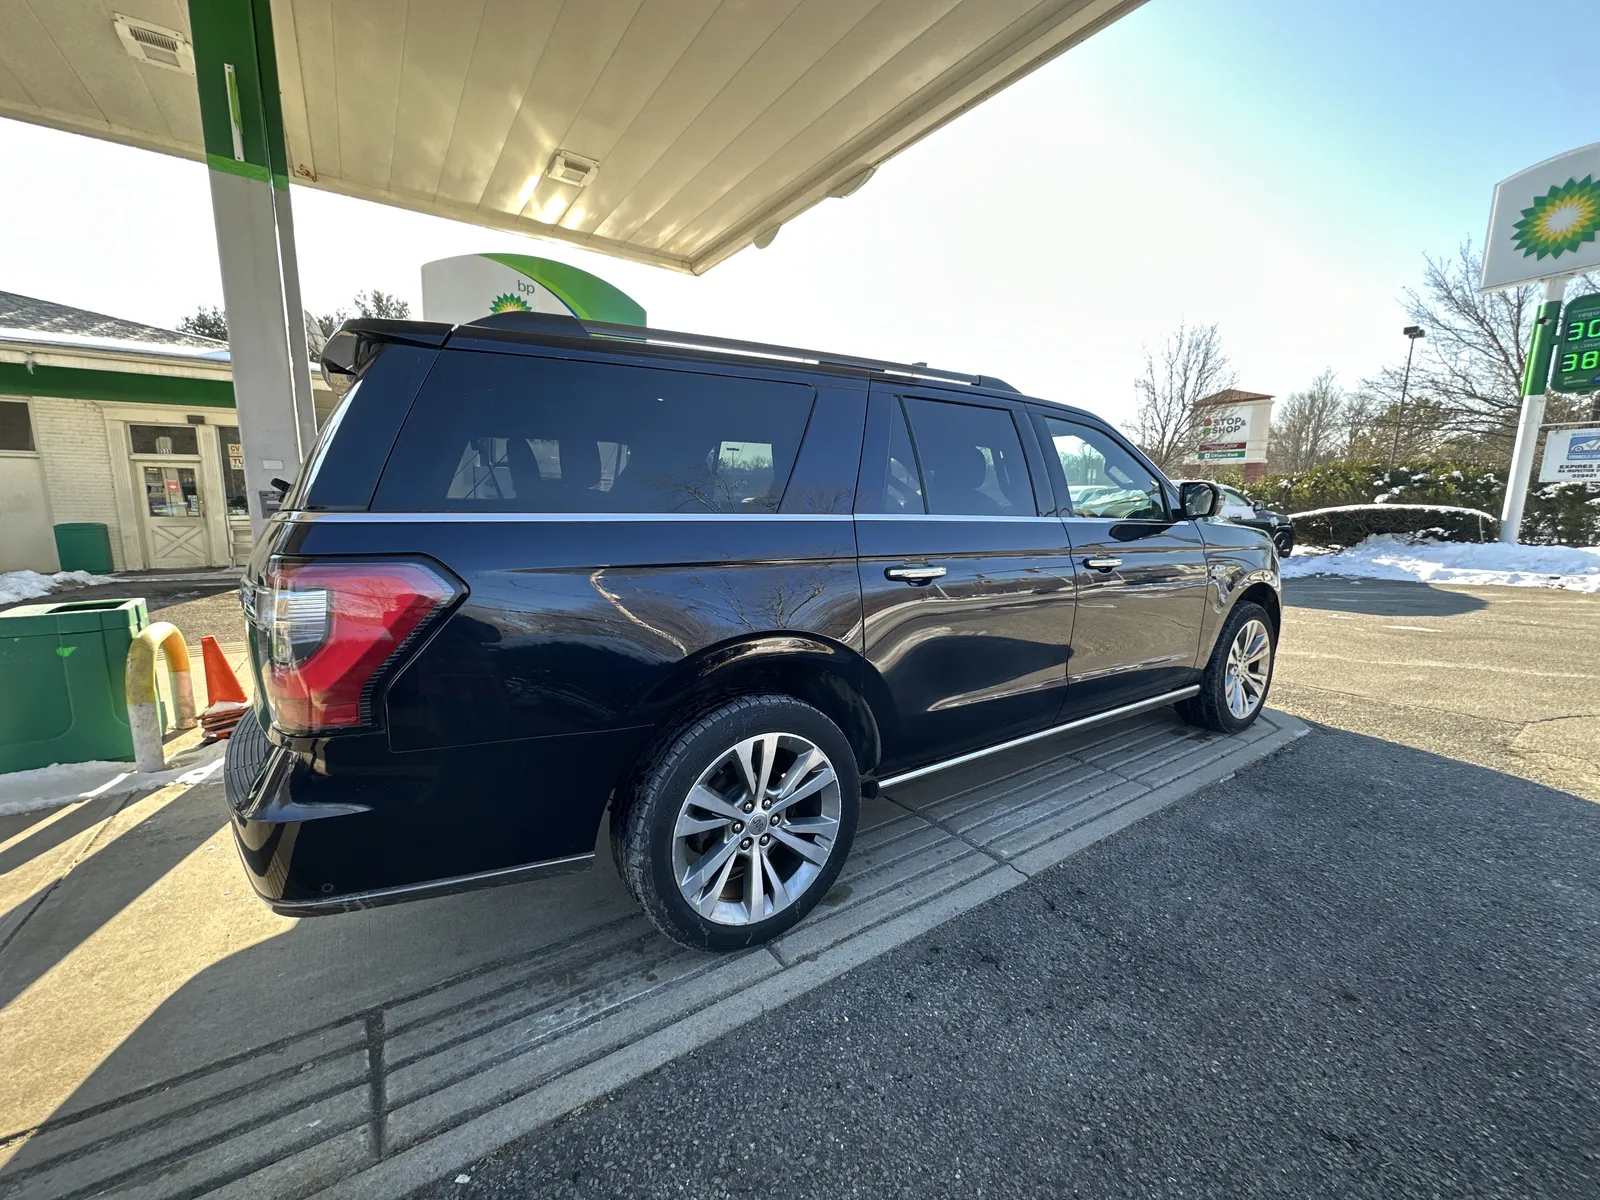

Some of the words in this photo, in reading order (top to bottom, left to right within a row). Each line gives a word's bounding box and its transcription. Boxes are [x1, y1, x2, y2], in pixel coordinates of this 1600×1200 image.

[517, 280, 535, 296] bp
[1562, 350, 1600, 373] 38
[1214, 417, 1241, 425] STOP
[1212, 426, 1240, 434] SHOP
